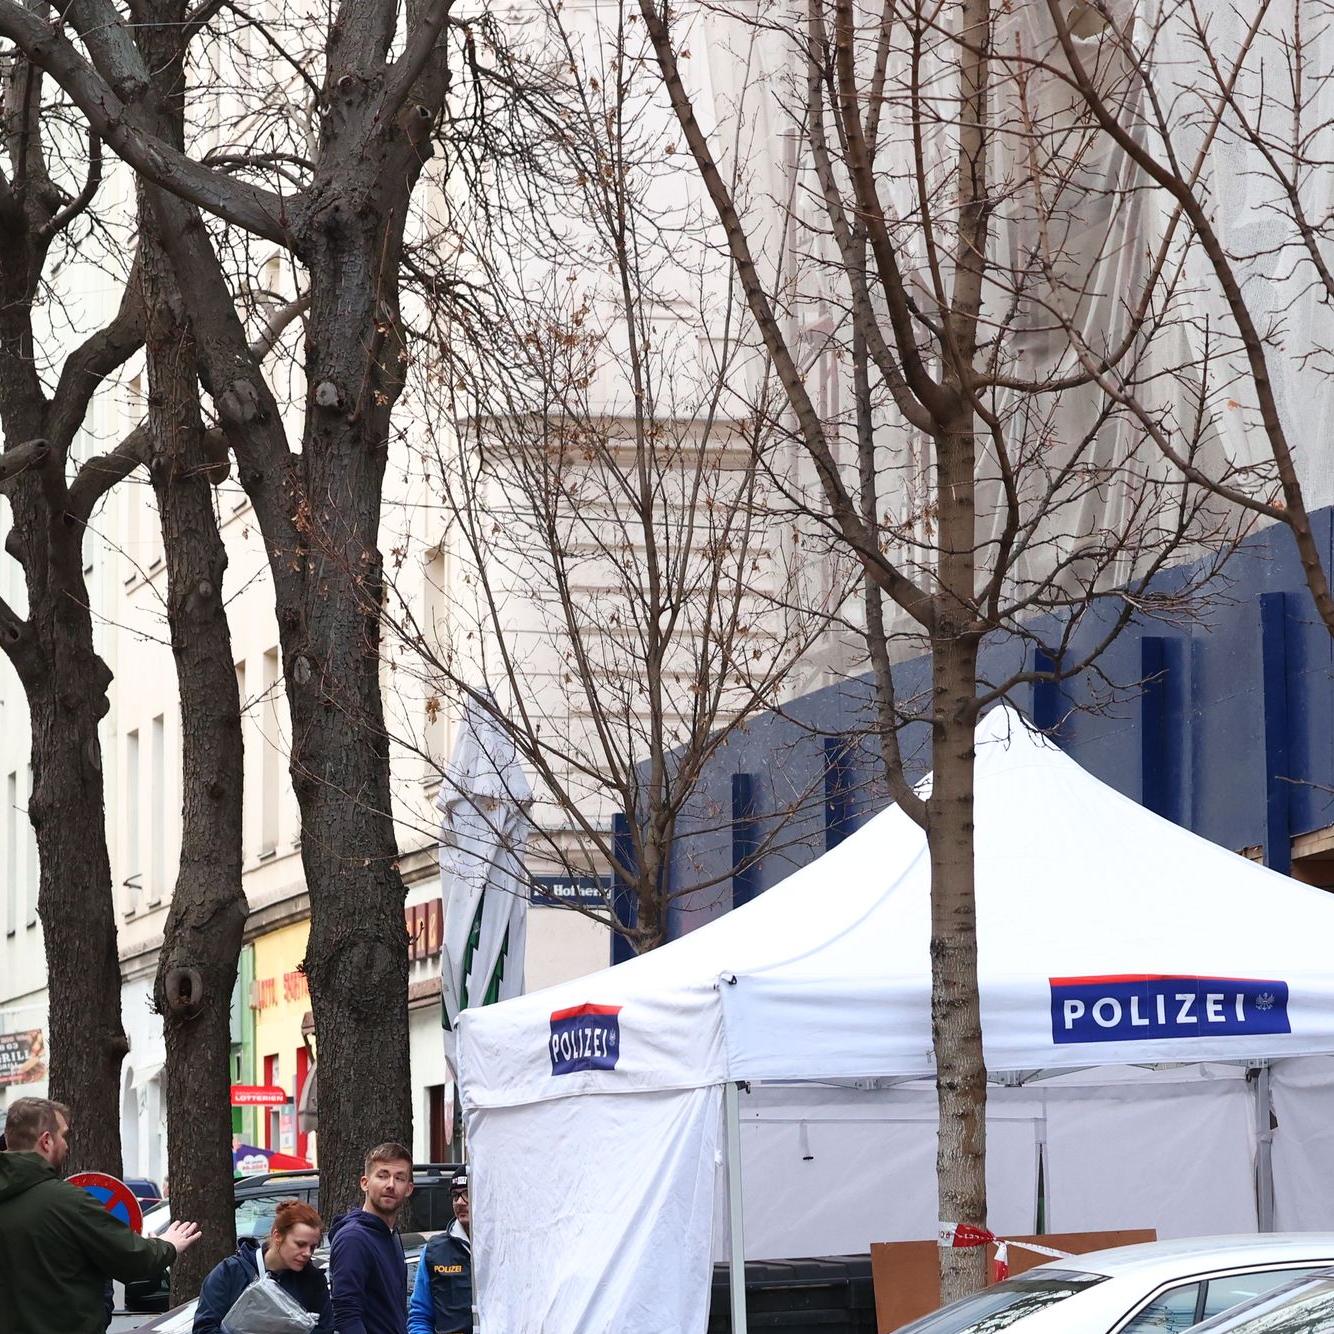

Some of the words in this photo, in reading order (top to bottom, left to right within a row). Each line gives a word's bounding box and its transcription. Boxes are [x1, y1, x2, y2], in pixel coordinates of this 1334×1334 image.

[1064, 993, 1246, 1029] POLIZEI
[552, 1028, 608, 1062] POLIZEI
[434, 1265, 462, 1273] POLIZEI
